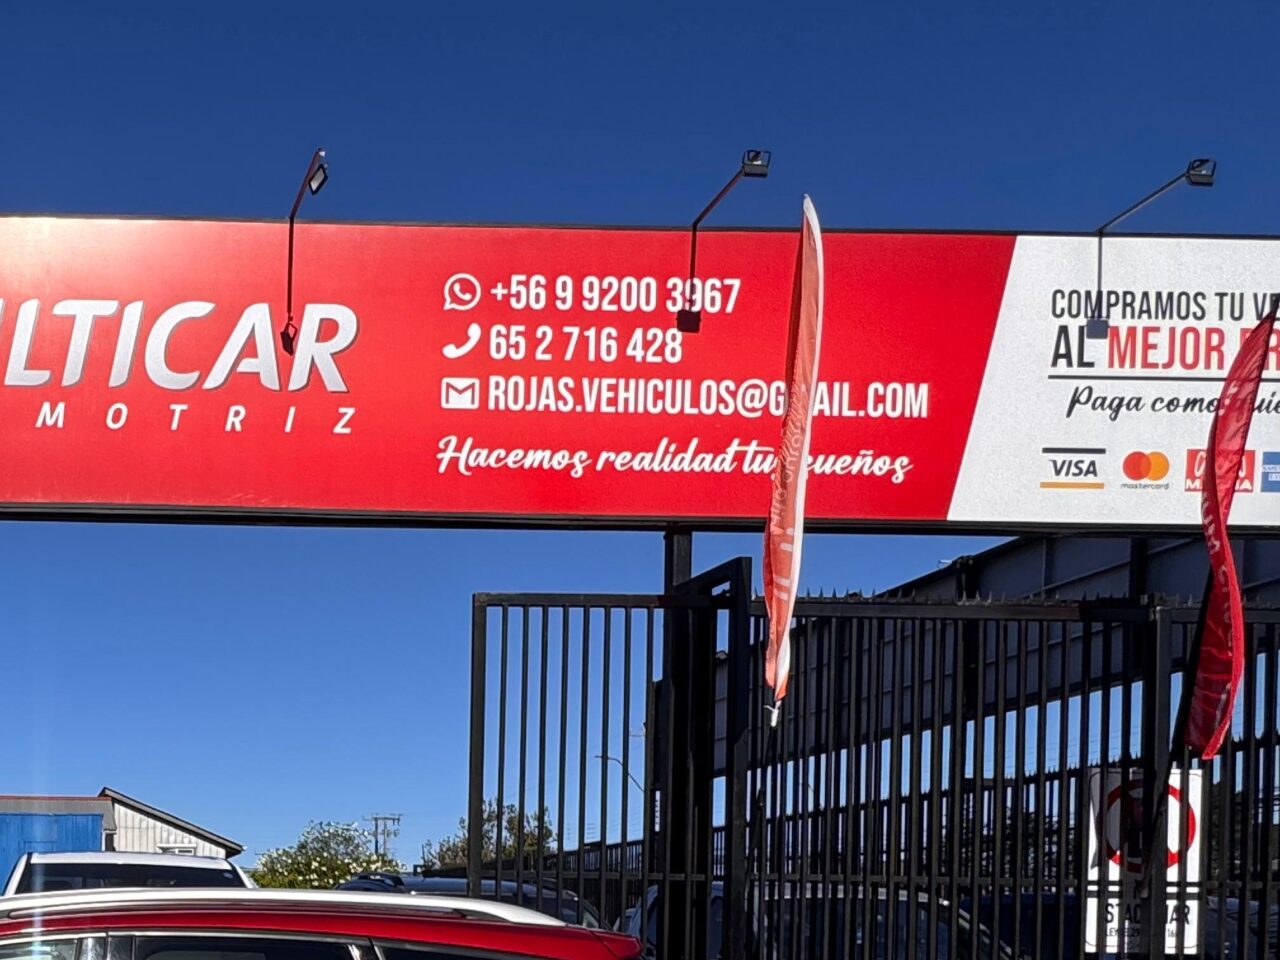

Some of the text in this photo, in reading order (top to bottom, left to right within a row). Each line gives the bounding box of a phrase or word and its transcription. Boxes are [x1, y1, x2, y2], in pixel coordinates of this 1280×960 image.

[489, 275, 741, 313] +56 9 9200 3967
[1051, 288, 1207, 321] COMPRAMOS
[1214, 292, 1245, 322] TU
[489, 324, 683, 363] 65 2 716 428
[1051, 325, 1095, 368] AL
[1107, 325, 1225, 371] MEJOR
[488, 375, 929, 419] ROJAS.VEHICULOS@GAIL.COM
[1066, 385, 1145, 422] Paga
[1151, 395, 1220, 414] como
[436, 435, 591, 478] Hacemos
[596, 437, 739, 473] realidad
[1048, 458, 1098, 478] VISA
